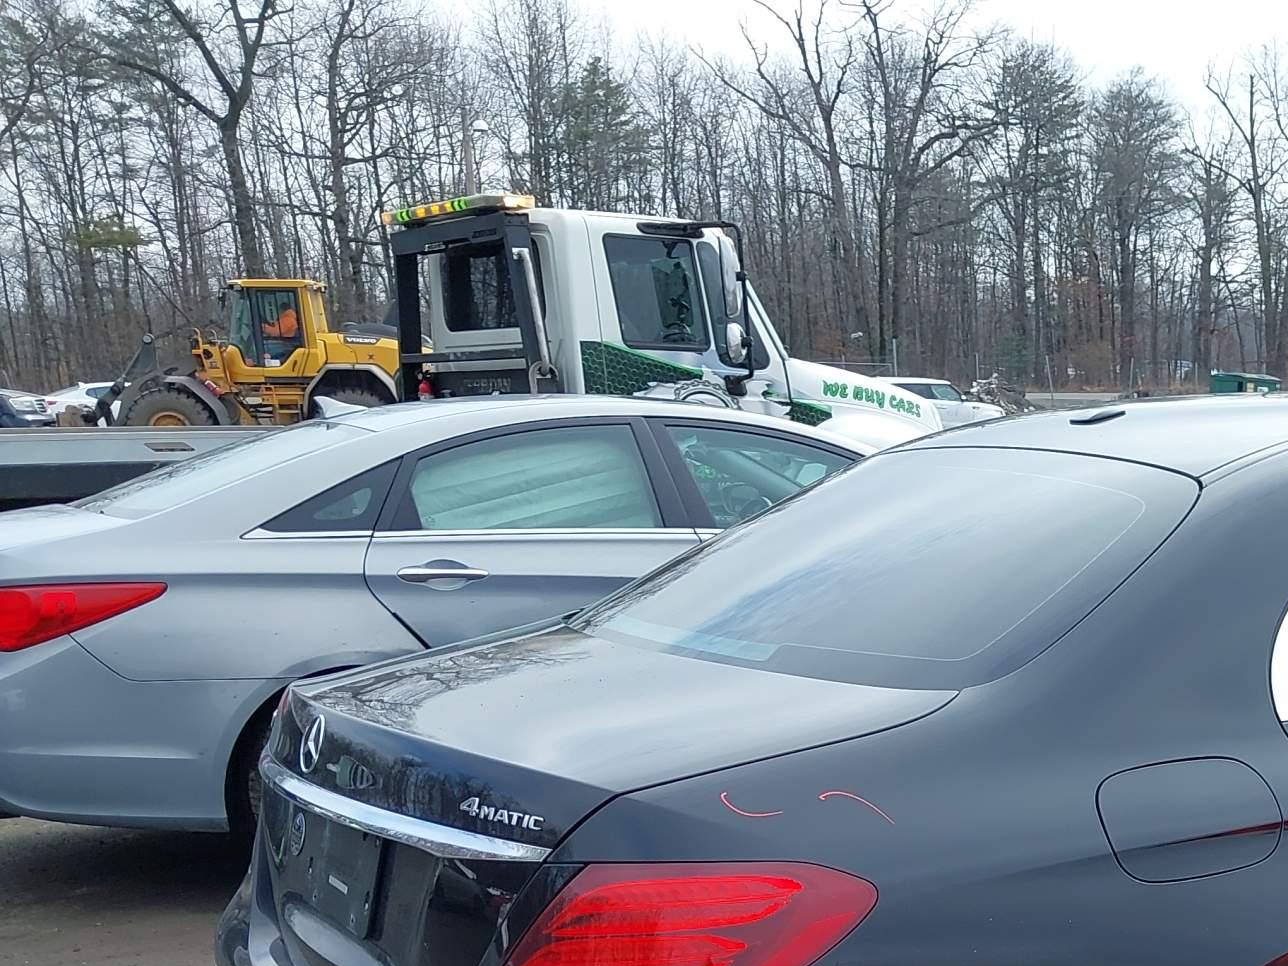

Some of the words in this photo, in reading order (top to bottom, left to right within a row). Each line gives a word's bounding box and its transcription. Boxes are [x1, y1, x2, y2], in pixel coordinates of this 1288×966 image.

[822, 379, 848, 398] WE
[852, 385, 885, 409] BUY
[889, 394, 921, 418] CARS
[459, 796, 545, 831] 4MATIC
